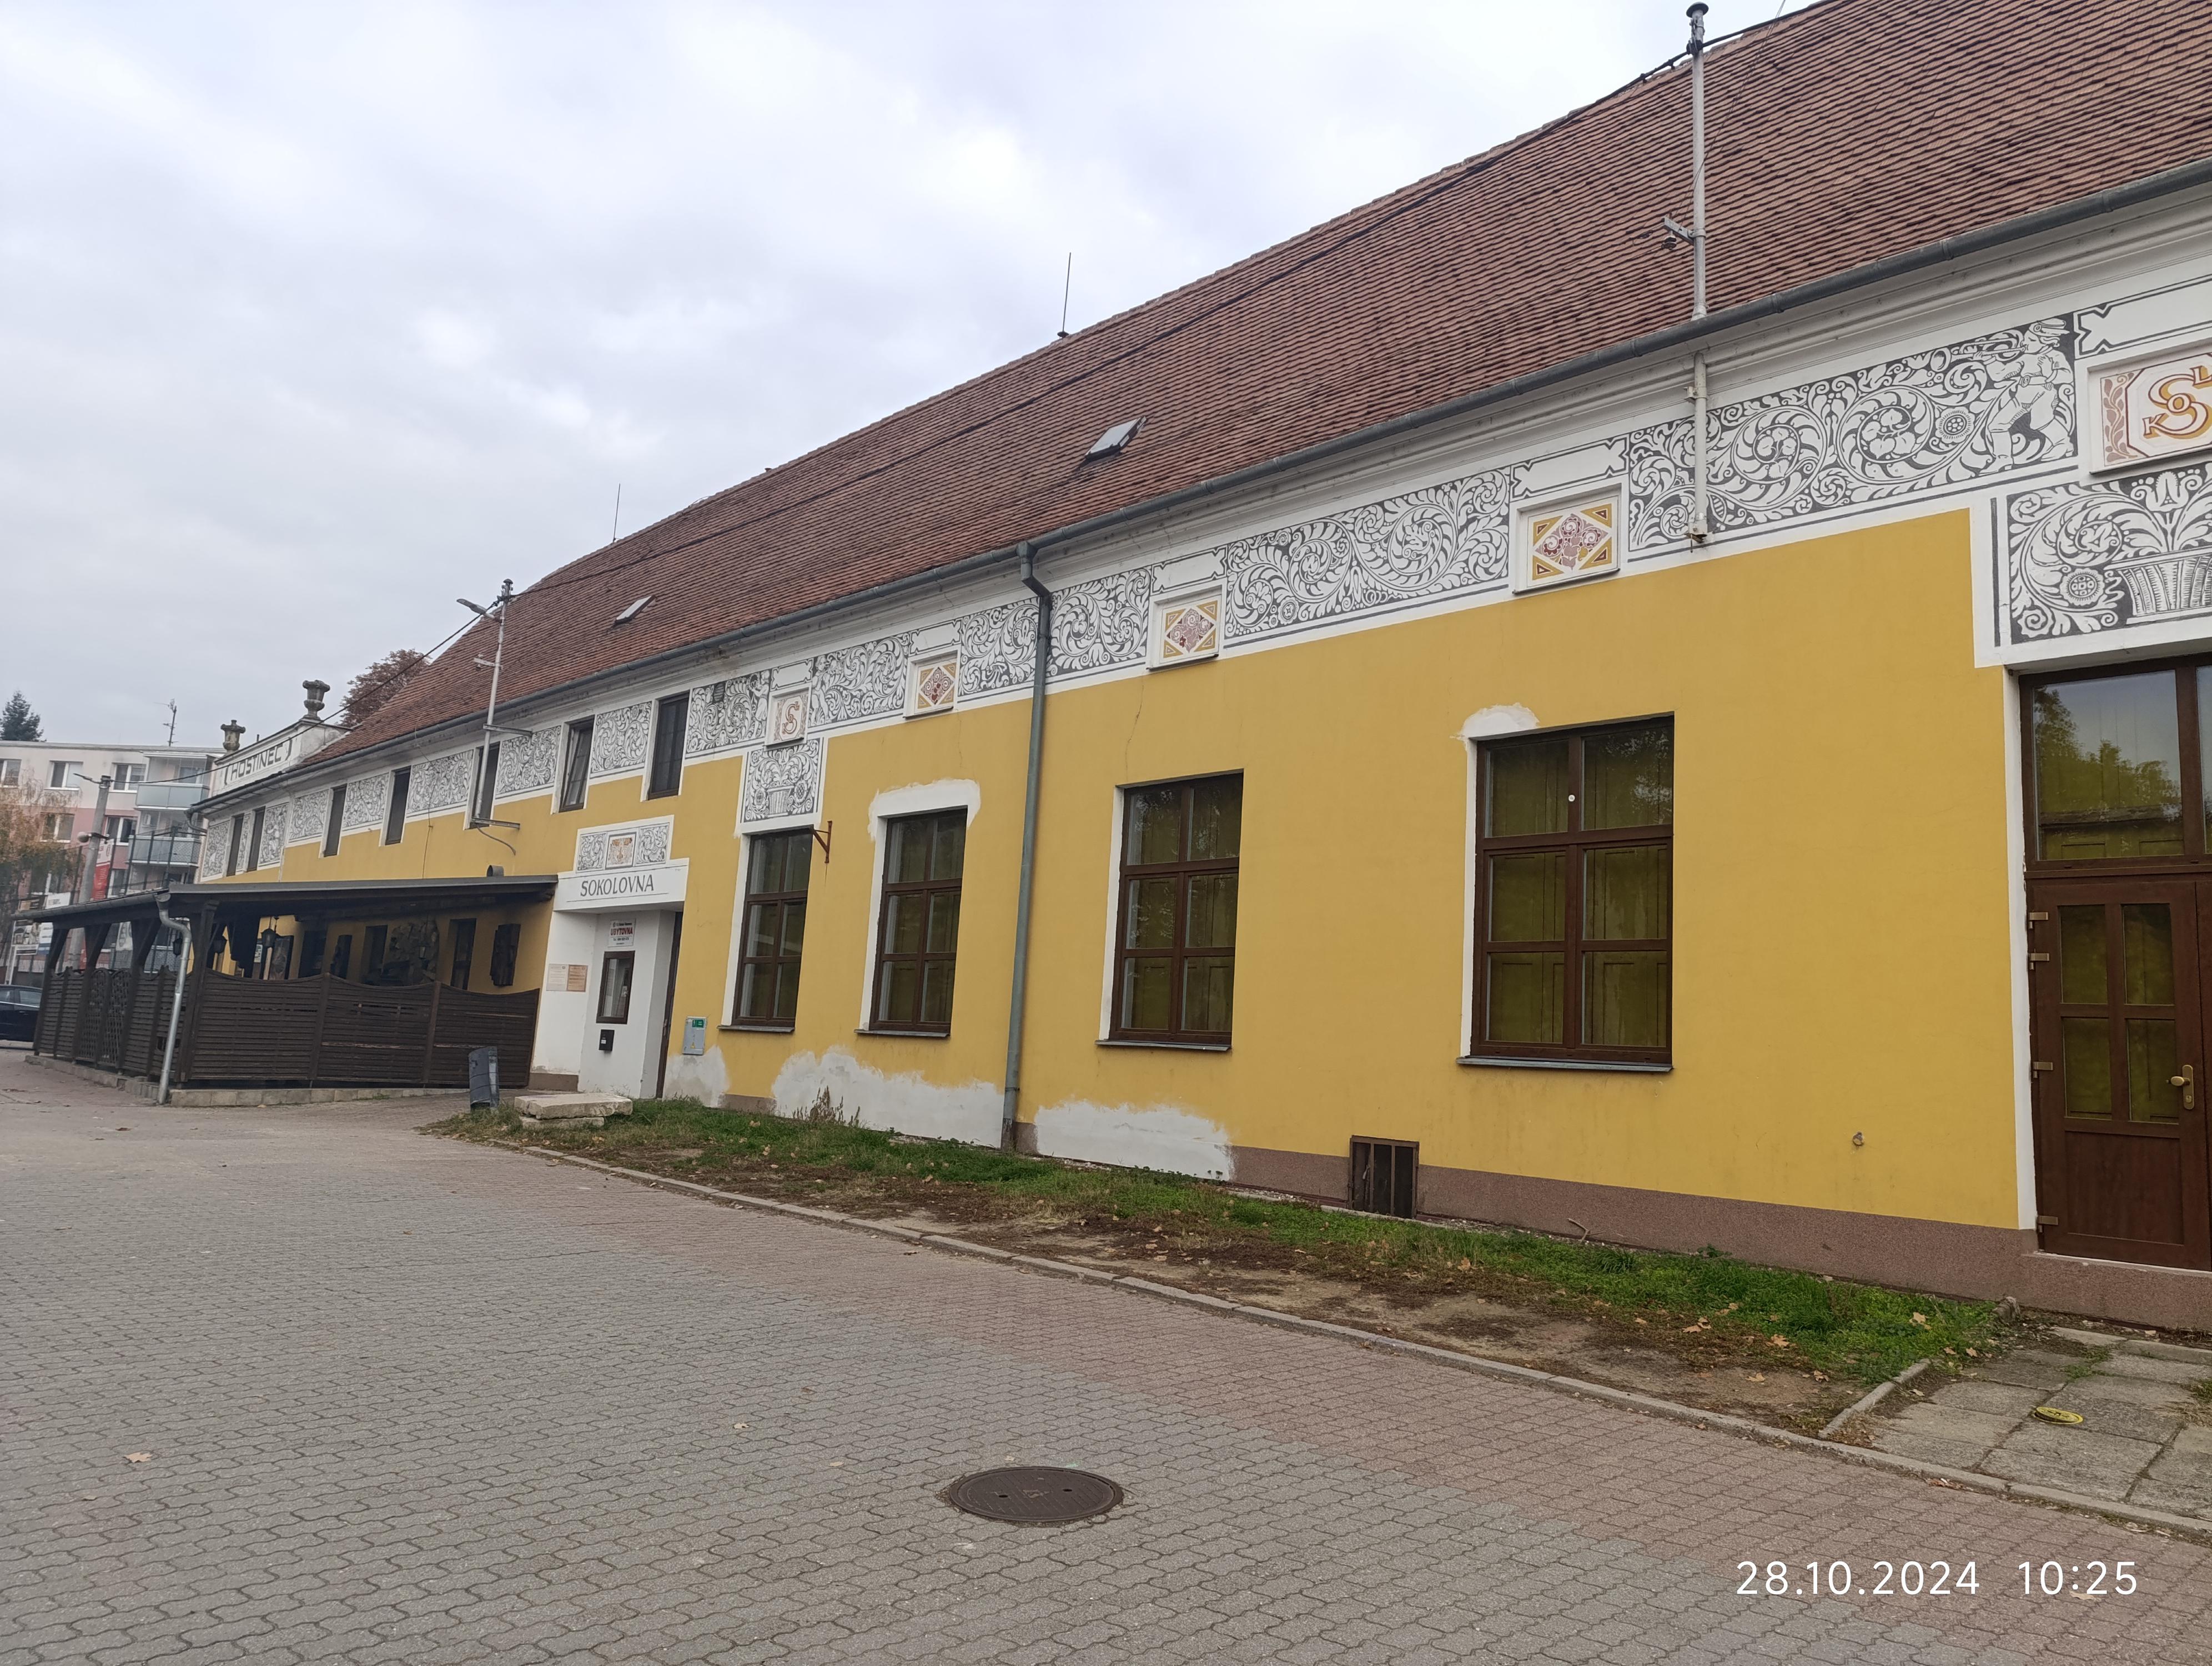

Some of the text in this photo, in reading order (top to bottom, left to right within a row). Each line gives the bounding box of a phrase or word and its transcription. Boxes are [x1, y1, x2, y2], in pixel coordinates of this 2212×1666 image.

[230, 743, 283, 781] HOSTINEC
[580, 874, 654, 897] SOKOLOVNA
[610, 927, 633, 936] UBYTOVNA
